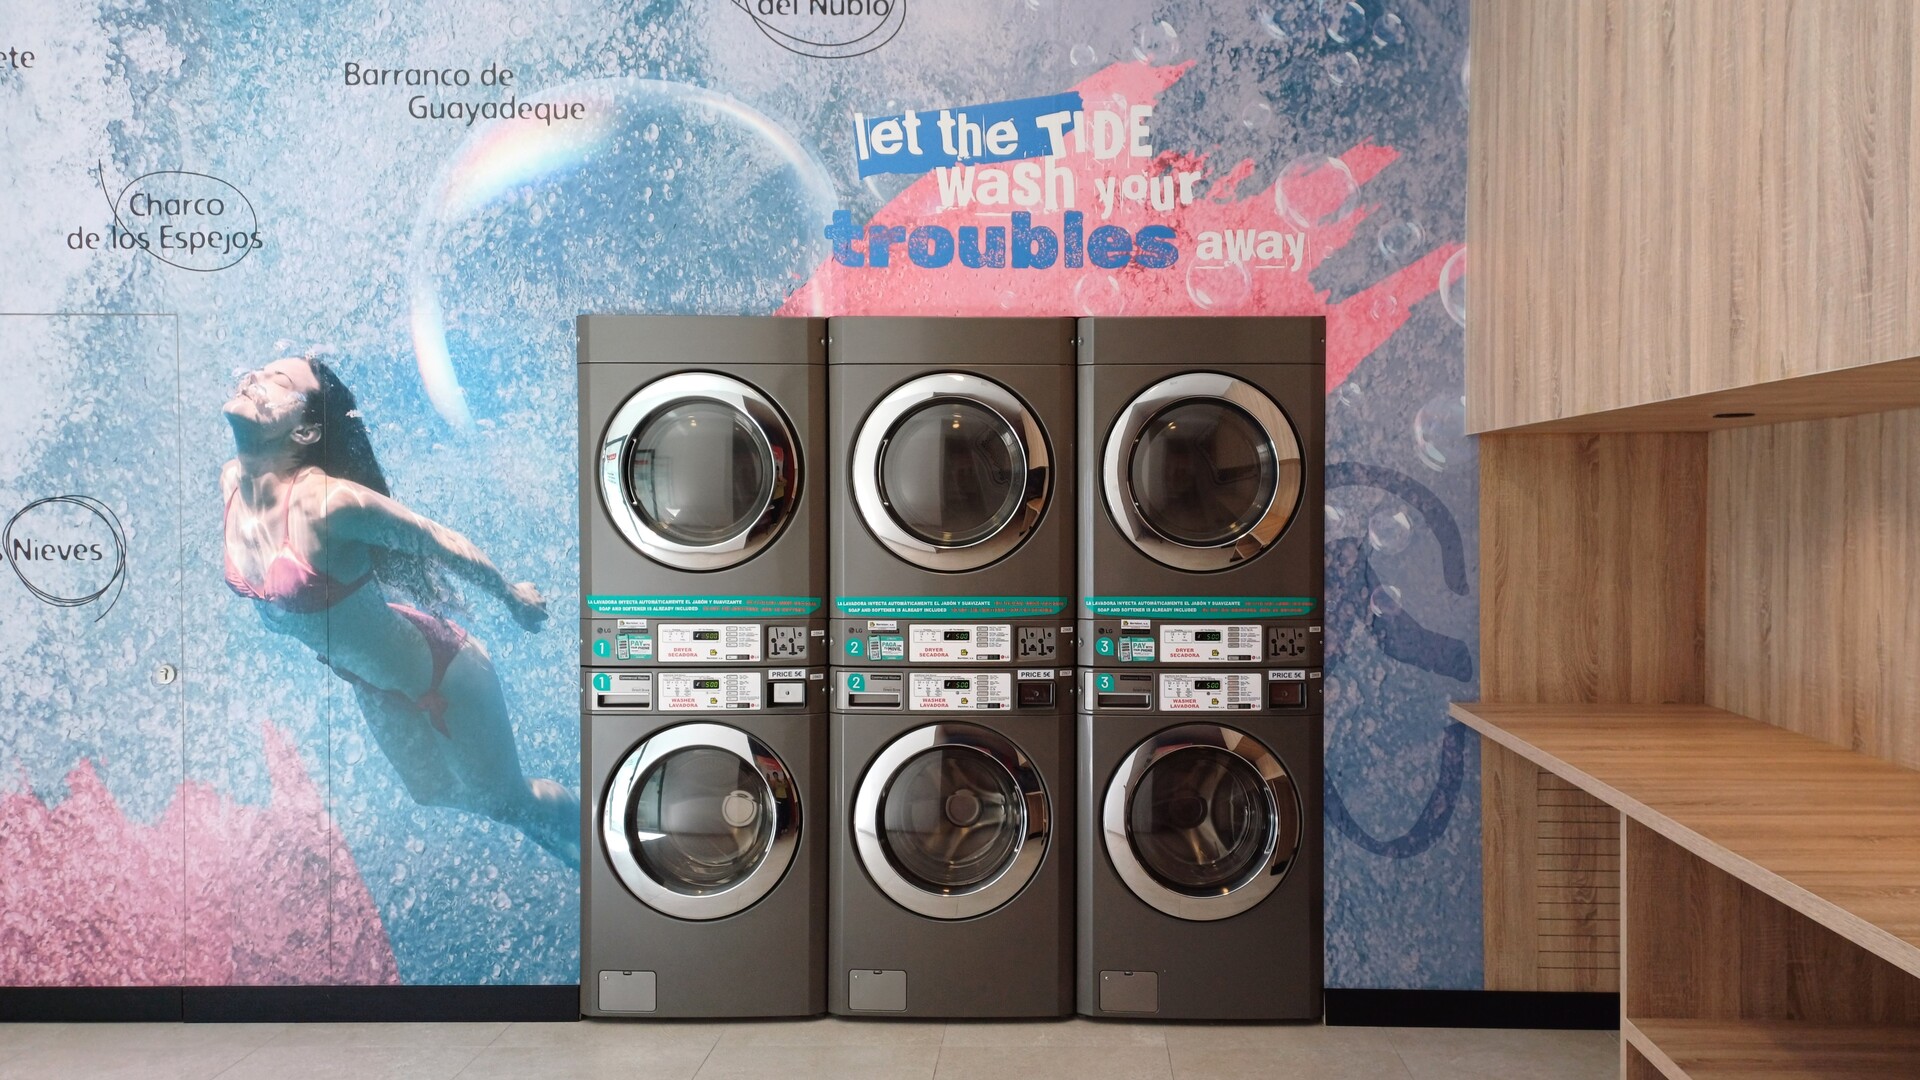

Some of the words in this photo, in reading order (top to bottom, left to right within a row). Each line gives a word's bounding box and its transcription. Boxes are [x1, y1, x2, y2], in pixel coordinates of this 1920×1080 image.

[758, 0, 798, 15] del
[810, 0, 890, 16] Nublo
[344, 62, 470, 86] Barranco
[480, 62, 514, 86] de
[408, 95, 586, 127] Guayadeque
[854, 110, 924, 160] let
[937, 110, 1019, 159] the
[1036, 104, 1153, 160] TIDE
[936, 161, 1076, 211] wash
[1093, 170, 1202, 219] your
[129, 193, 225, 216] Charco
[67, 226, 100, 250] de
[112, 225, 150, 249] los
[160, 225, 264, 255] Espejos
[826, 209, 1179, 269] troubles
[1196, 226, 1306, 272] away
[13, 538, 103, 561] Nieves
[599, 642, 604, 655] 1
[850, 641, 858, 654] 2
[1101, 640, 1108, 653] 3
[599, 676, 604, 689] 1
[852, 676, 860, 689] 2
[1101, 676, 1109, 689] 3
